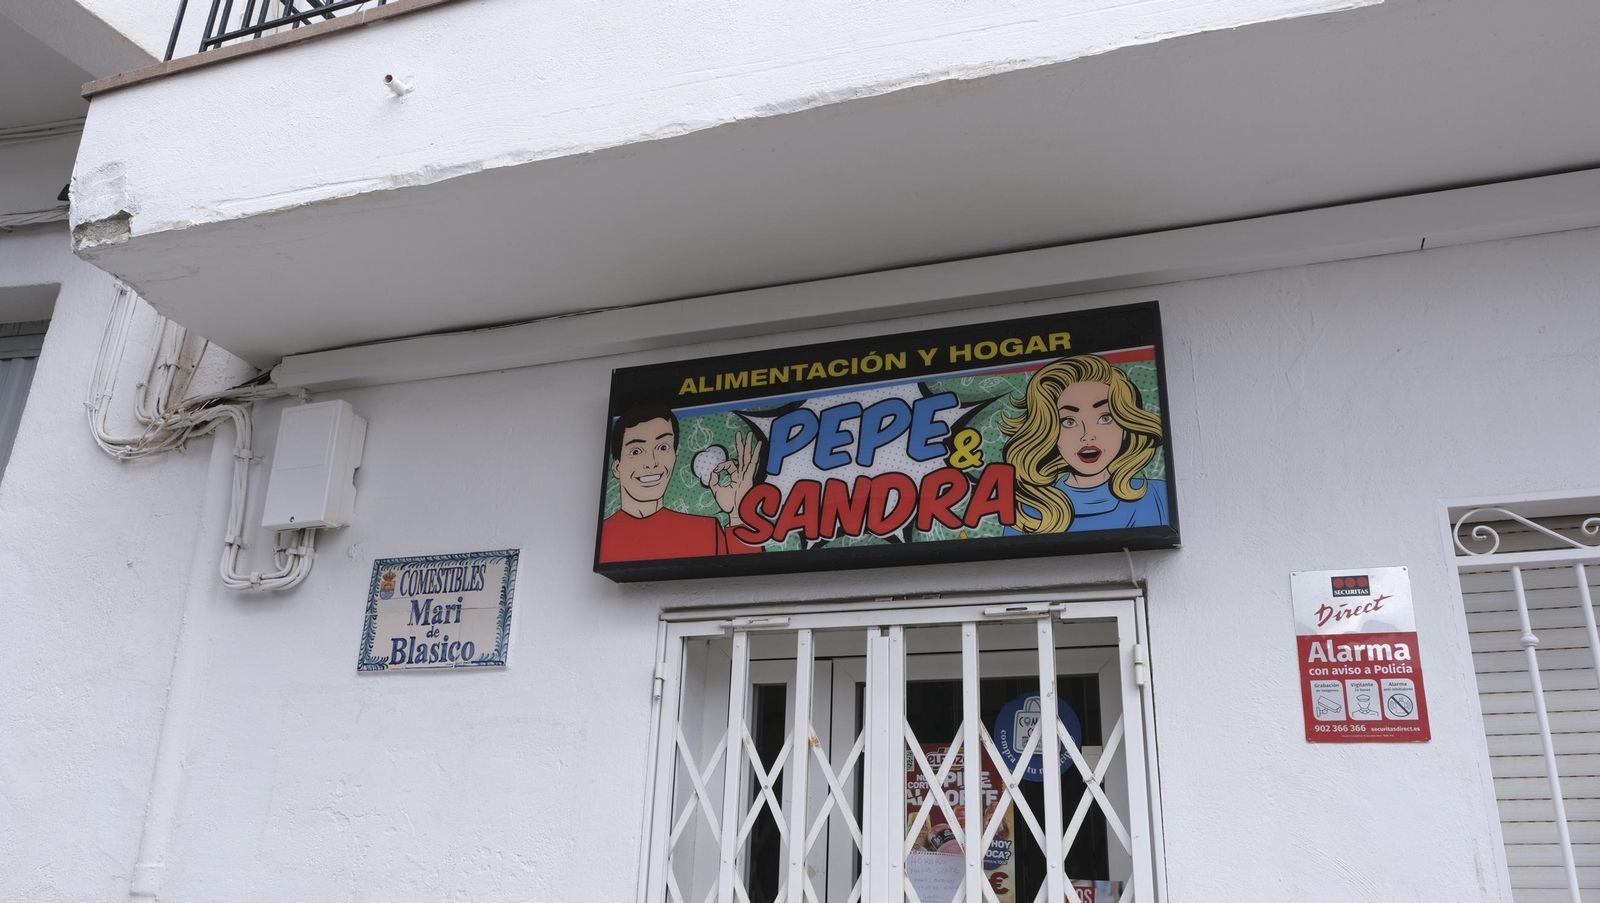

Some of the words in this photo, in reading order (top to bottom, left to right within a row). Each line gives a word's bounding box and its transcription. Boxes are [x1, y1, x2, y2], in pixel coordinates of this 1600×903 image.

[678, 351, 907, 394] ALIMENTACIÓN
[916, 347, 939, 367] Y
[949, 331, 1072, 363] HOGAR
[766, 391, 959, 476] PEPE
[948, 428, 984, 470] &
[733, 462, 1016, 544] SANDRA
[400, 564, 487, 597] COMESTIBLES
[1334, 588, 1369, 596] SECURITAS
[407, 596, 463, 626] Mari
[1314, 594, 1393, 627] Direct
[426, 626, 440, 638] de
[389, 635, 475, 665] Blasico
[1308, 639, 1411, 663] Alarma
[1309, 666, 1329, 676] con
[1332, 665, 1361, 675] aviso
[1364, 666, 1372, 675] a
[1374, 663, 1413, 674] Policía
[1350, 724, 1367, 732] 366
[986, 851, 1011, 860] OCA?
